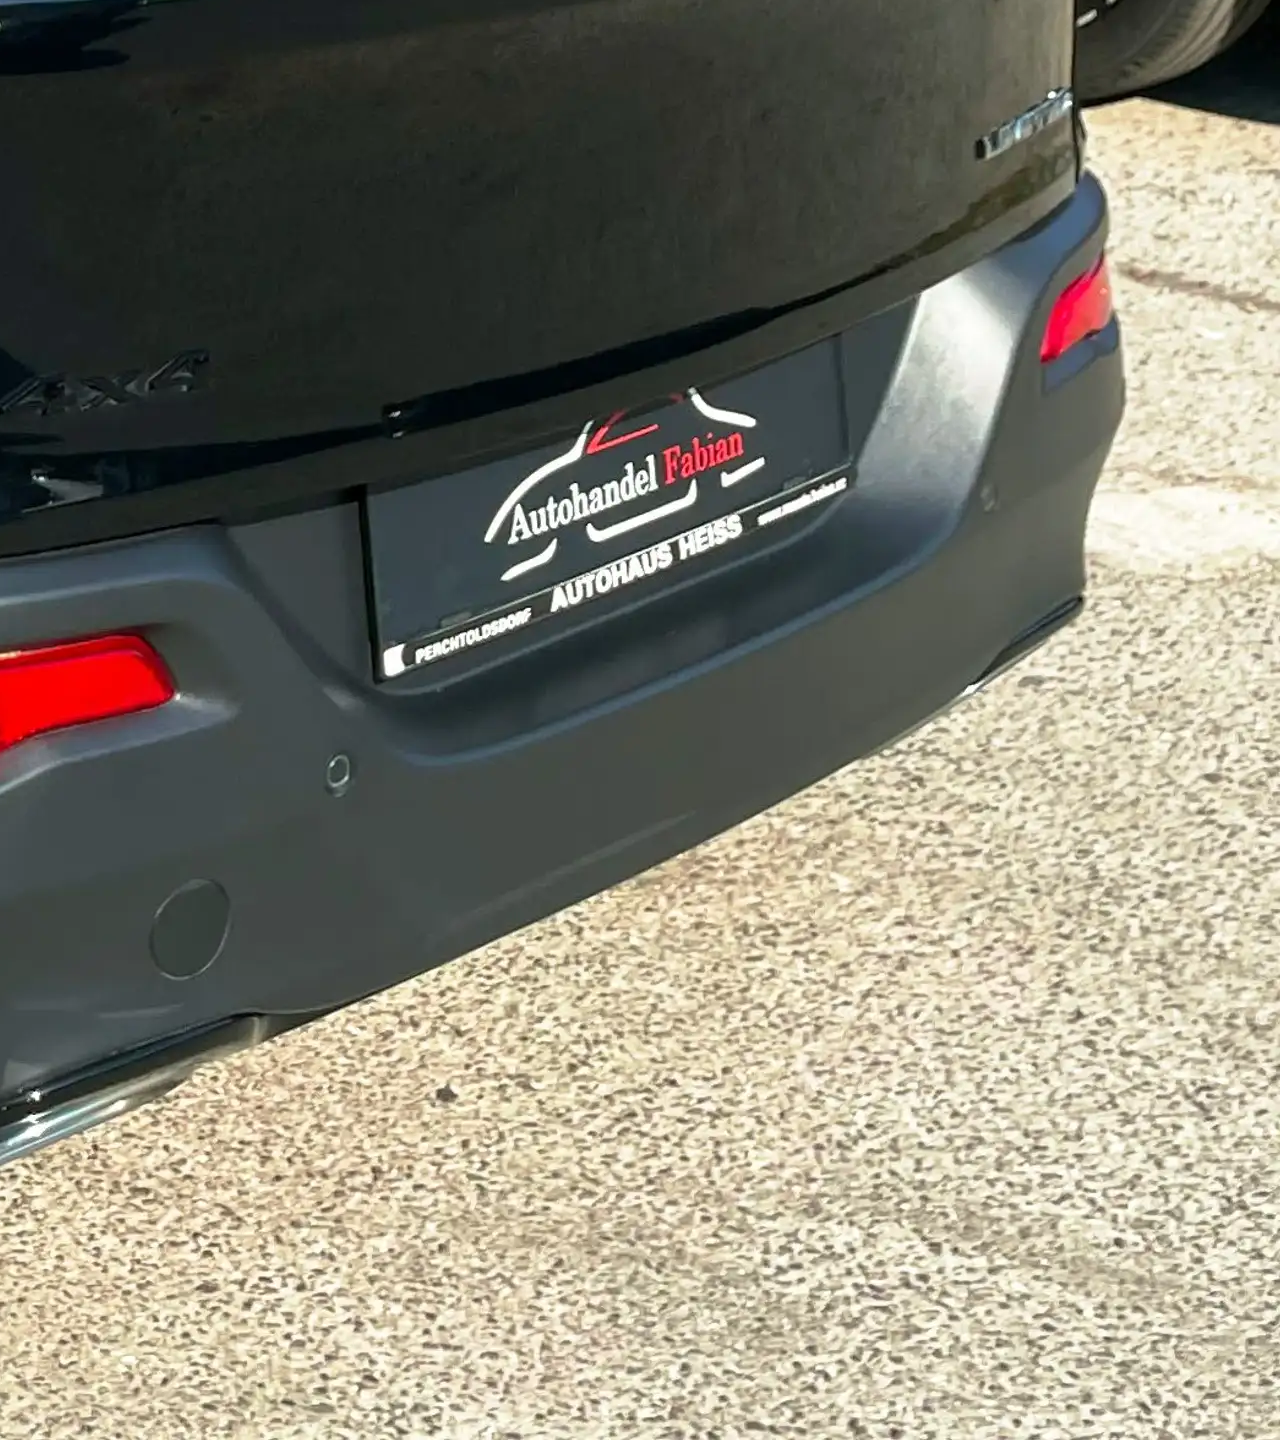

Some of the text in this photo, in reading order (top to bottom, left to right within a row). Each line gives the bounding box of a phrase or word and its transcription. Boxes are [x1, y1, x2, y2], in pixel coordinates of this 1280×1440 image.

[507, 431, 745, 545] Autohandel Fabian
[550, 543, 673, 613] AUTOHAUS
[678, 513, 744, 561] HEISS
